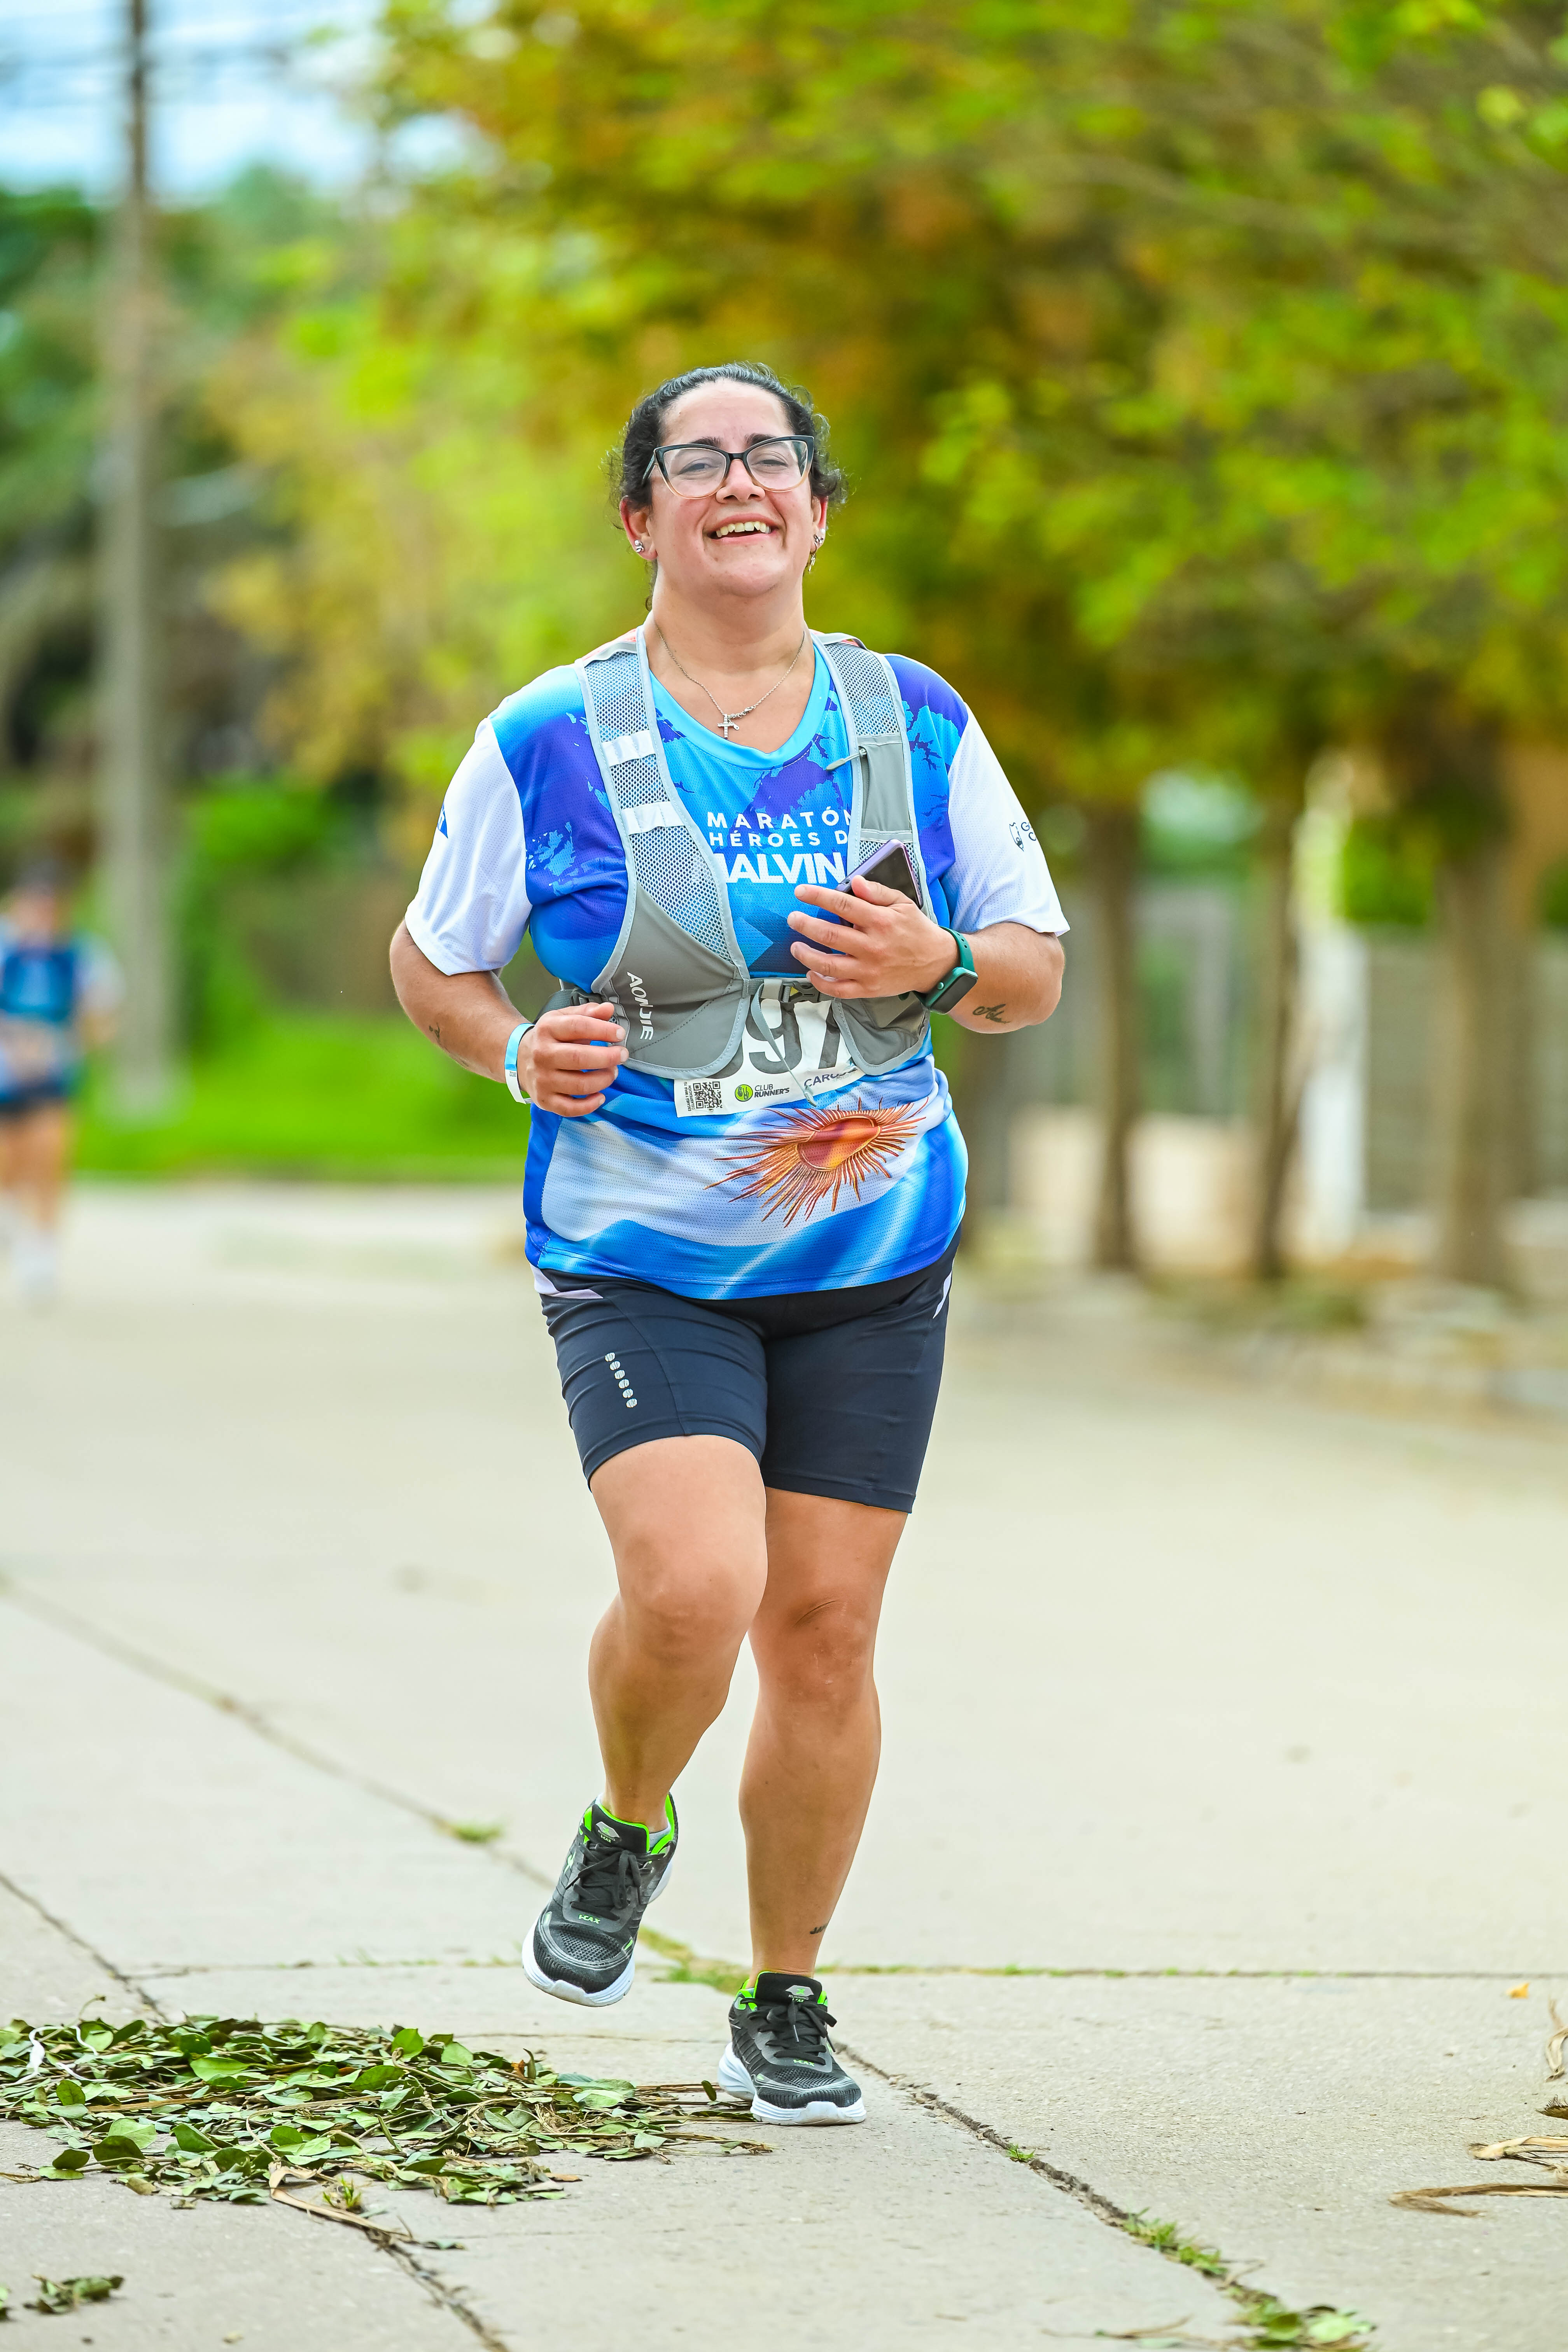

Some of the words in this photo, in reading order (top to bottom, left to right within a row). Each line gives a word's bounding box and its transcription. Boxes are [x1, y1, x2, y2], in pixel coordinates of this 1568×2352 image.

[709, 830, 821, 847] HÉROES
[713, 852, 846, 884] ALVIN
[754, 1088, 790, 1097] RUNNER'S
